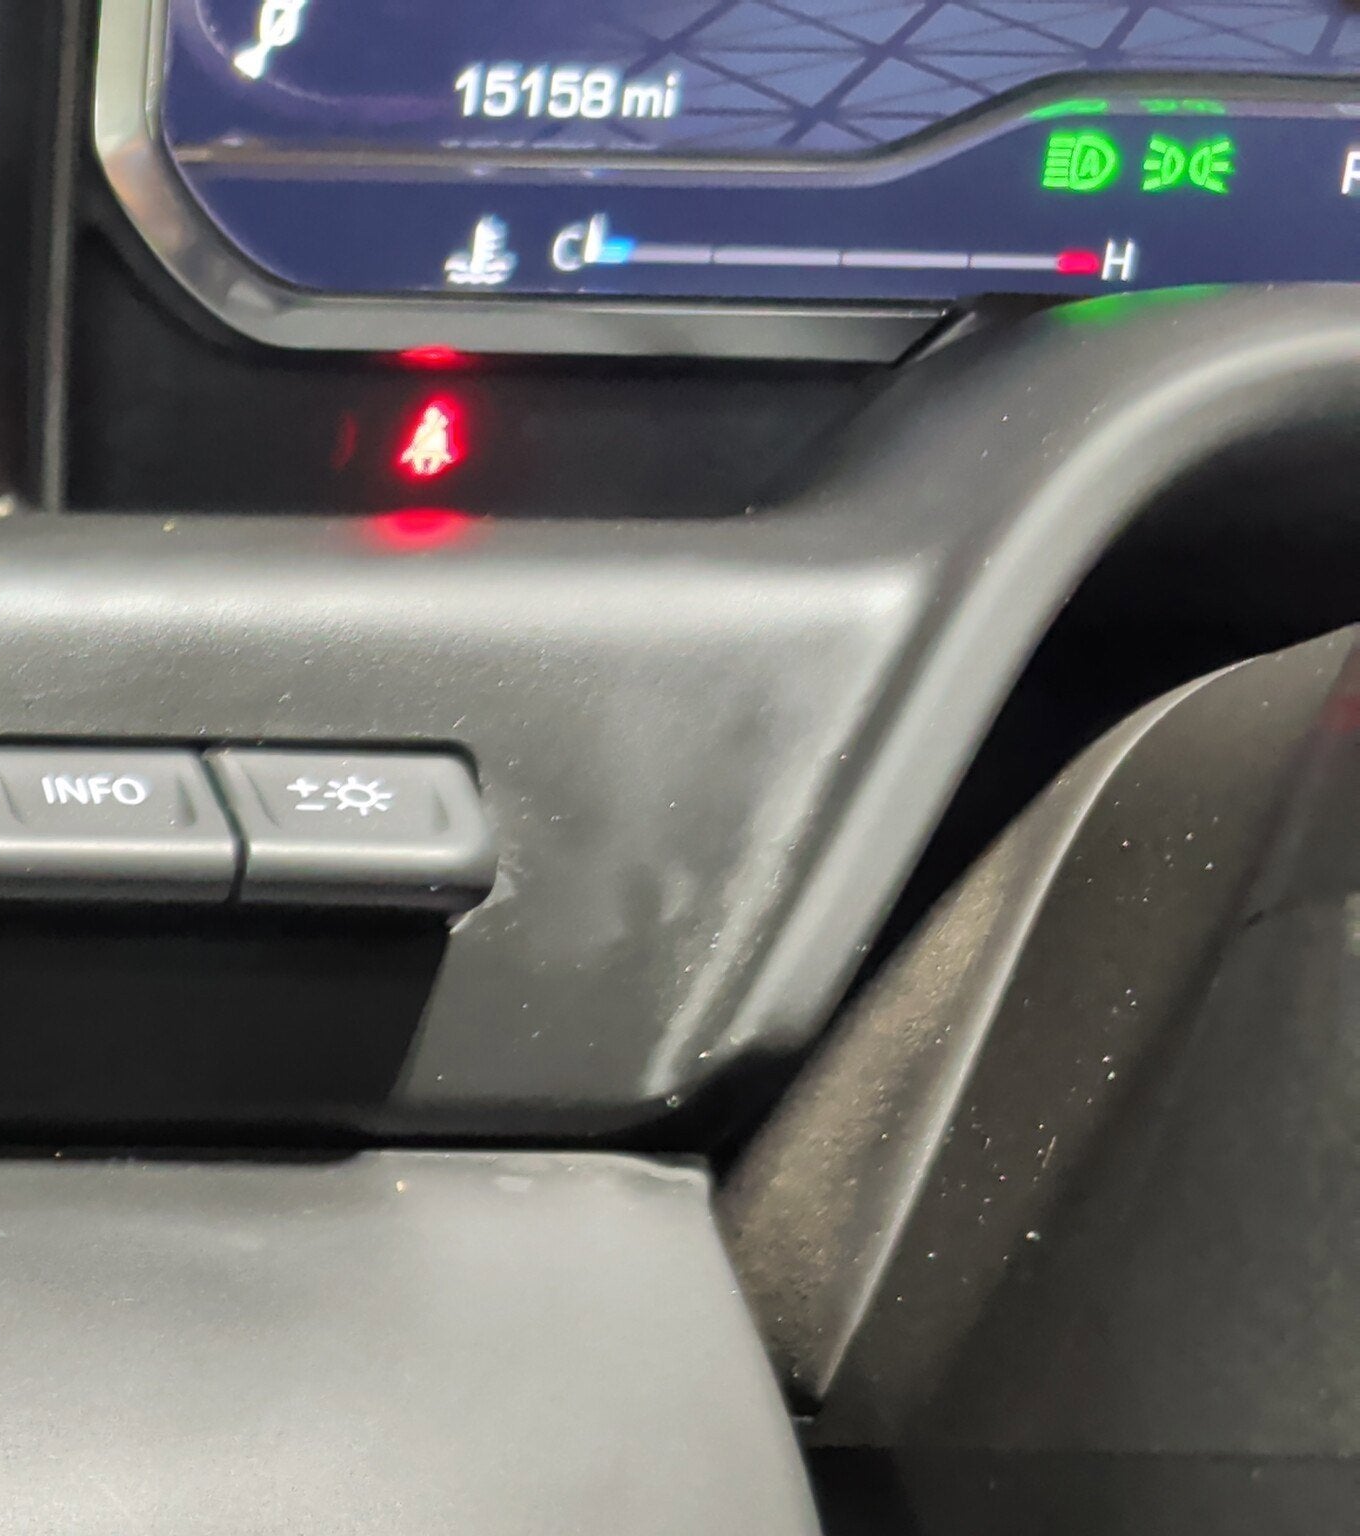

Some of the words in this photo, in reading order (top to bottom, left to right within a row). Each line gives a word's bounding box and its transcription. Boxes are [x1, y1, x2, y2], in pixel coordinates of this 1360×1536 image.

[454, 62, 618, 118] 15158
[621, 70, 682, 118] mi
[1100, 237, 1136, 282] H
[40, 773, 150, 806] INFO
